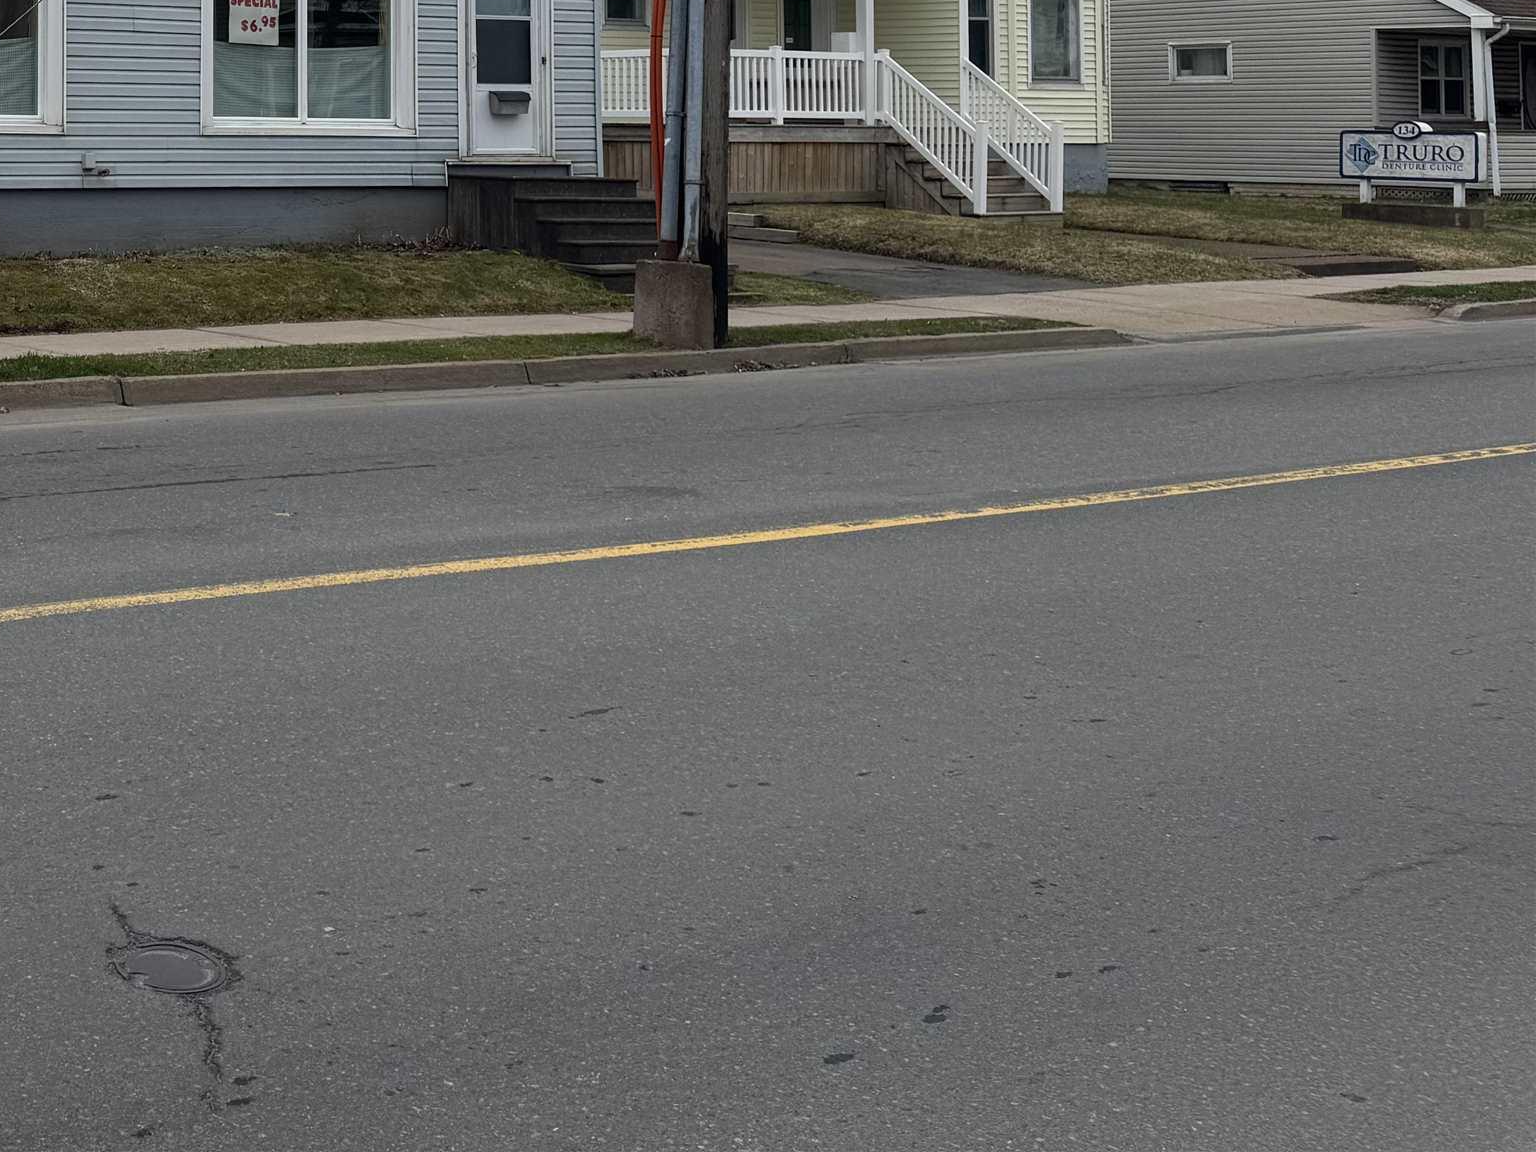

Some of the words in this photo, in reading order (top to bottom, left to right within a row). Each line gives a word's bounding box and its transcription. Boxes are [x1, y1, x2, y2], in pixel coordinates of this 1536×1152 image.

[240, 16, 277, 32] $6.95
[1397, 126, 1415, 135] 134
[1378, 144, 1465, 162] TRURO
[1381, 161, 1427, 171] DENTURE
[1429, 162, 1464, 172] CLINIC
